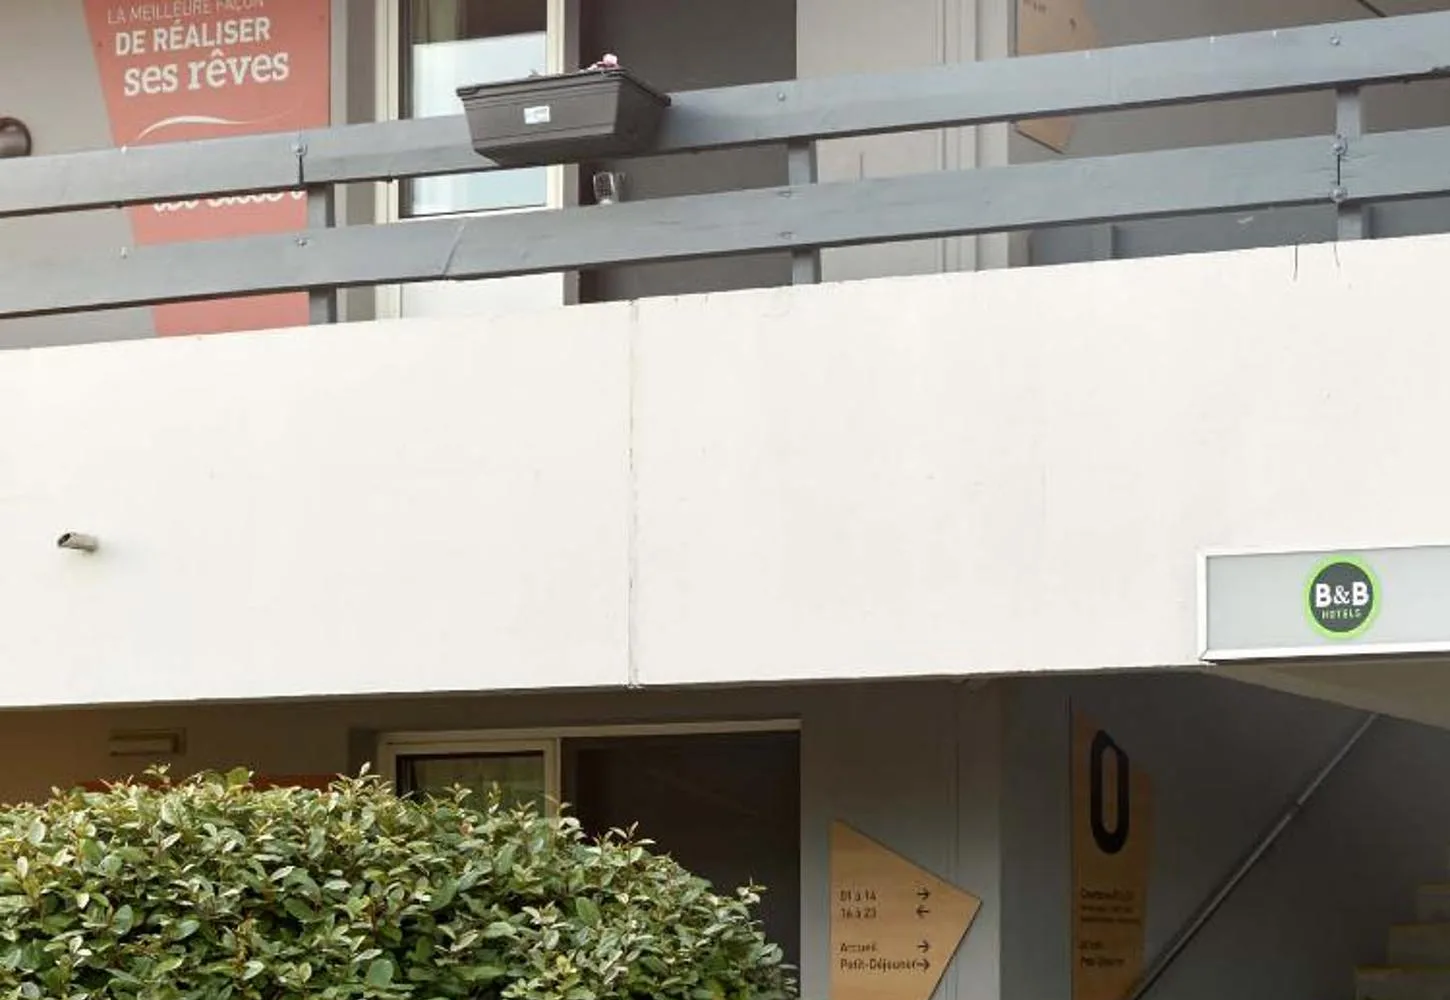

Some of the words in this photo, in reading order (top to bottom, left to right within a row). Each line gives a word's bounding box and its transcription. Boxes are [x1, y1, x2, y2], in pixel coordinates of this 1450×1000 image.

[107, 8, 126, 24] LA
[129, 0, 211, 21] MEILLEURE
[115, 30, 146, 56] DE
[153, 17, 271, 52] RÉALISER
[124, 63, 178, 96] ses
[188, 48, 289, 90] rêves
[1315, 581, 1370, 608] B&B
[1321, 608, 1362, 620] HOTELS
[1090, 729, 1130, 855] 0
